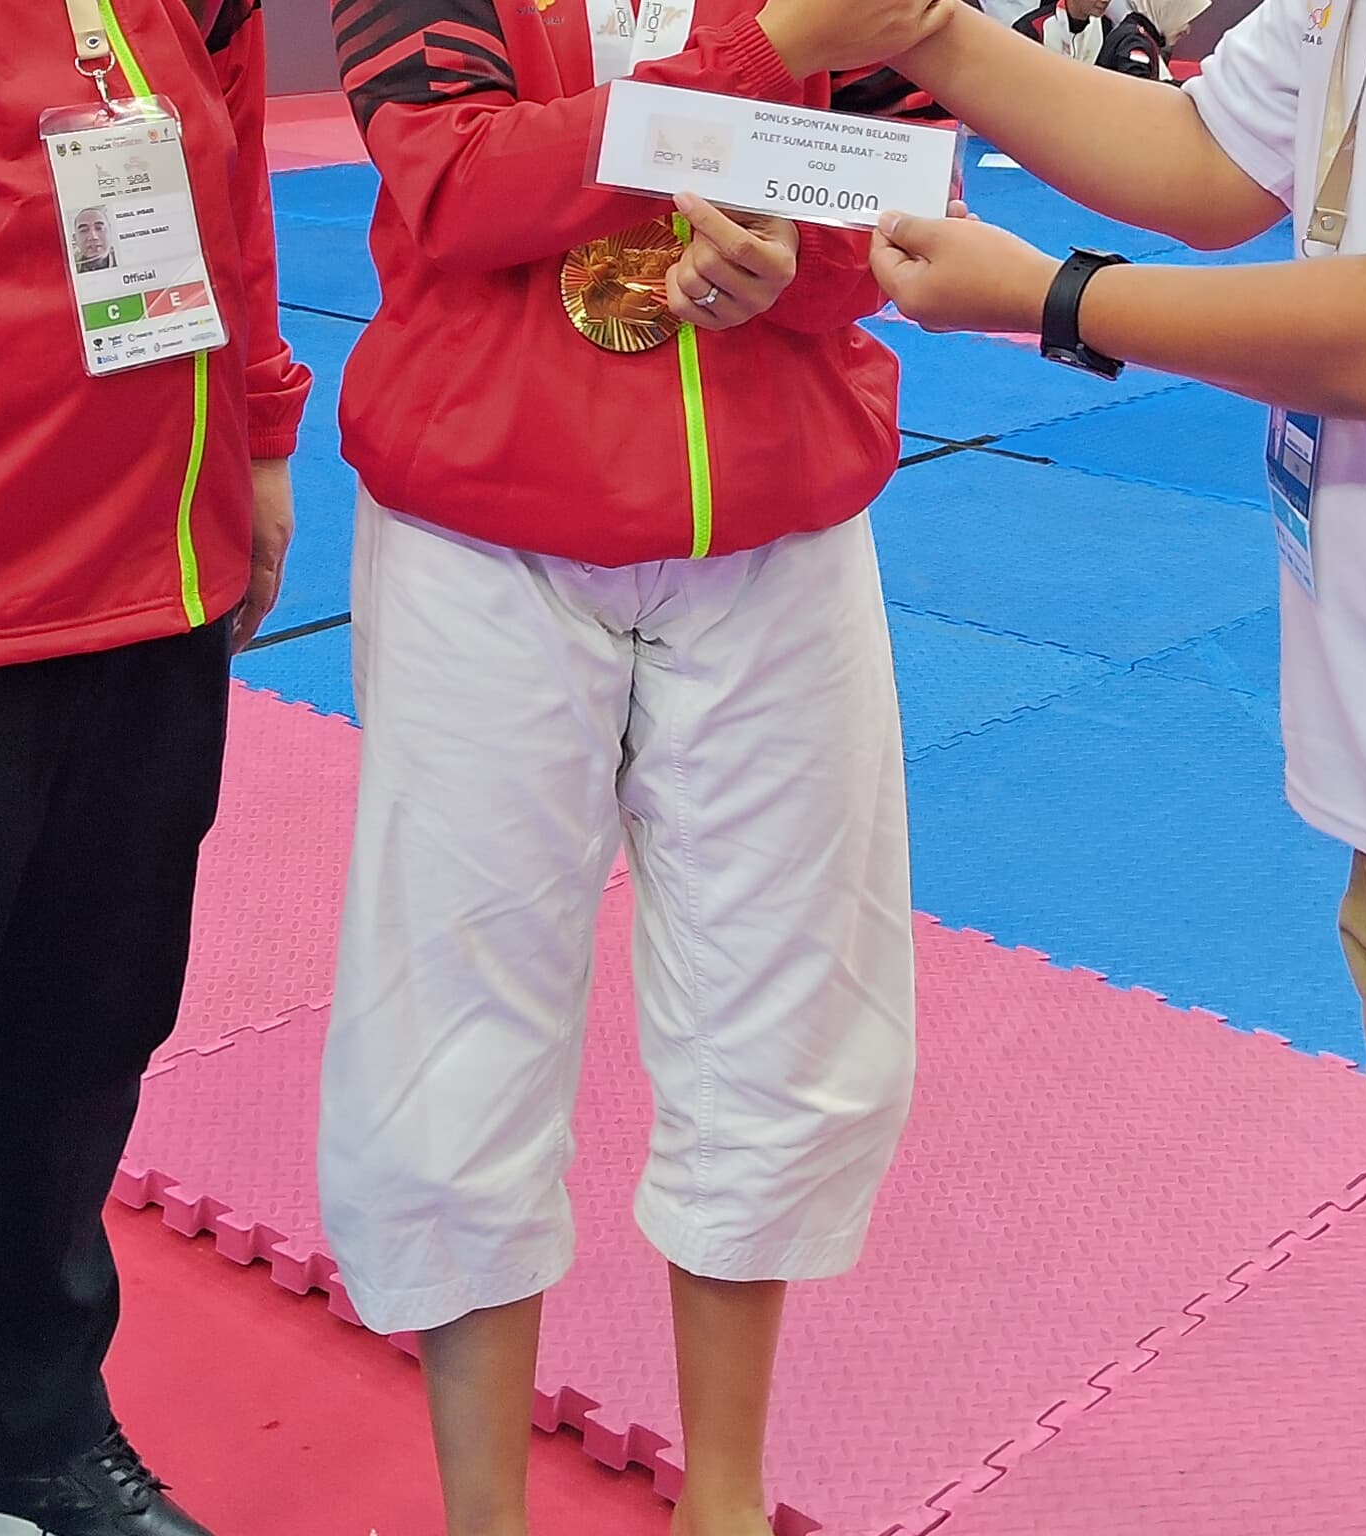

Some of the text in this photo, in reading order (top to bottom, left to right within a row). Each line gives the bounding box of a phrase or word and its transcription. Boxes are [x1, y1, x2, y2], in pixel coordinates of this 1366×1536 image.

[755, 112, 909, 142] BONUS SPONTAN PON BELADIRI
[751, 131, 781, 143] ATLET
[784, 136, 838, 151] SUMATERA
[841, 145, 874, 157] BARAT
[884, 152, 907, 162] 2025
[808, 160, 835, 171] GOLD
[765, 180, 879, 211] 5.000.000
[123, 270, 156, 284] Official
[108, 292, 181, 320] C E
